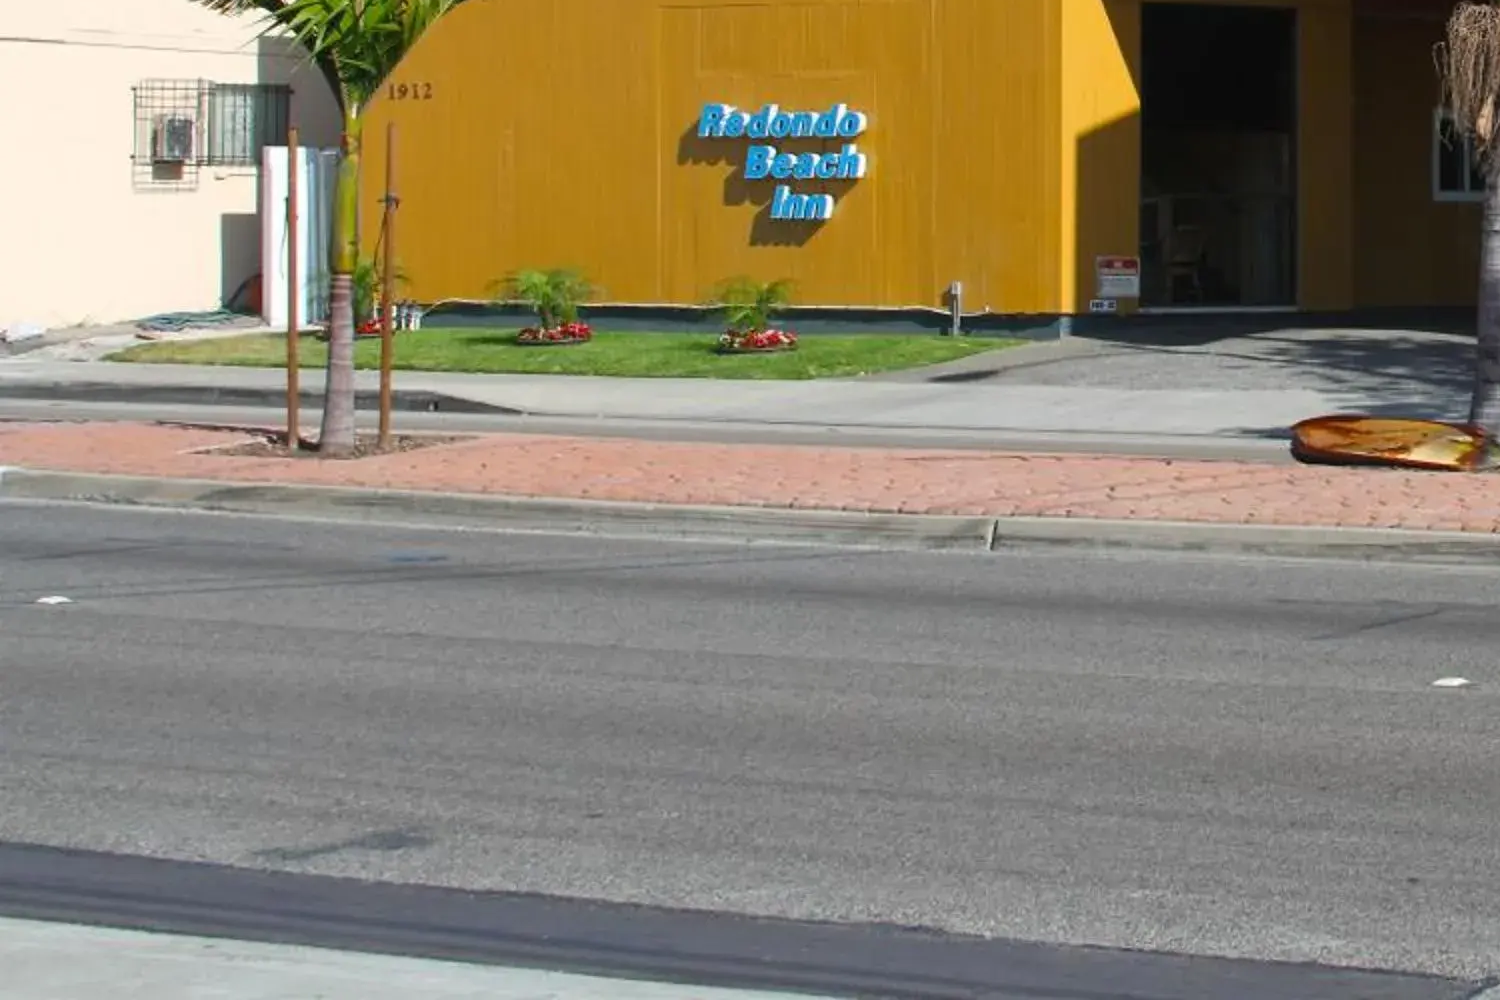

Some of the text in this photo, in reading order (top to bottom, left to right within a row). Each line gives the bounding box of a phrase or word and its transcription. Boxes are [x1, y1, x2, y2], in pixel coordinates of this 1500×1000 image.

[389, 83, 432, 100] 1912
[698, 103, 867, 137] Redondo
[744, 144, 866, 178] Beach
[770, 185, 834, 218] Inn
